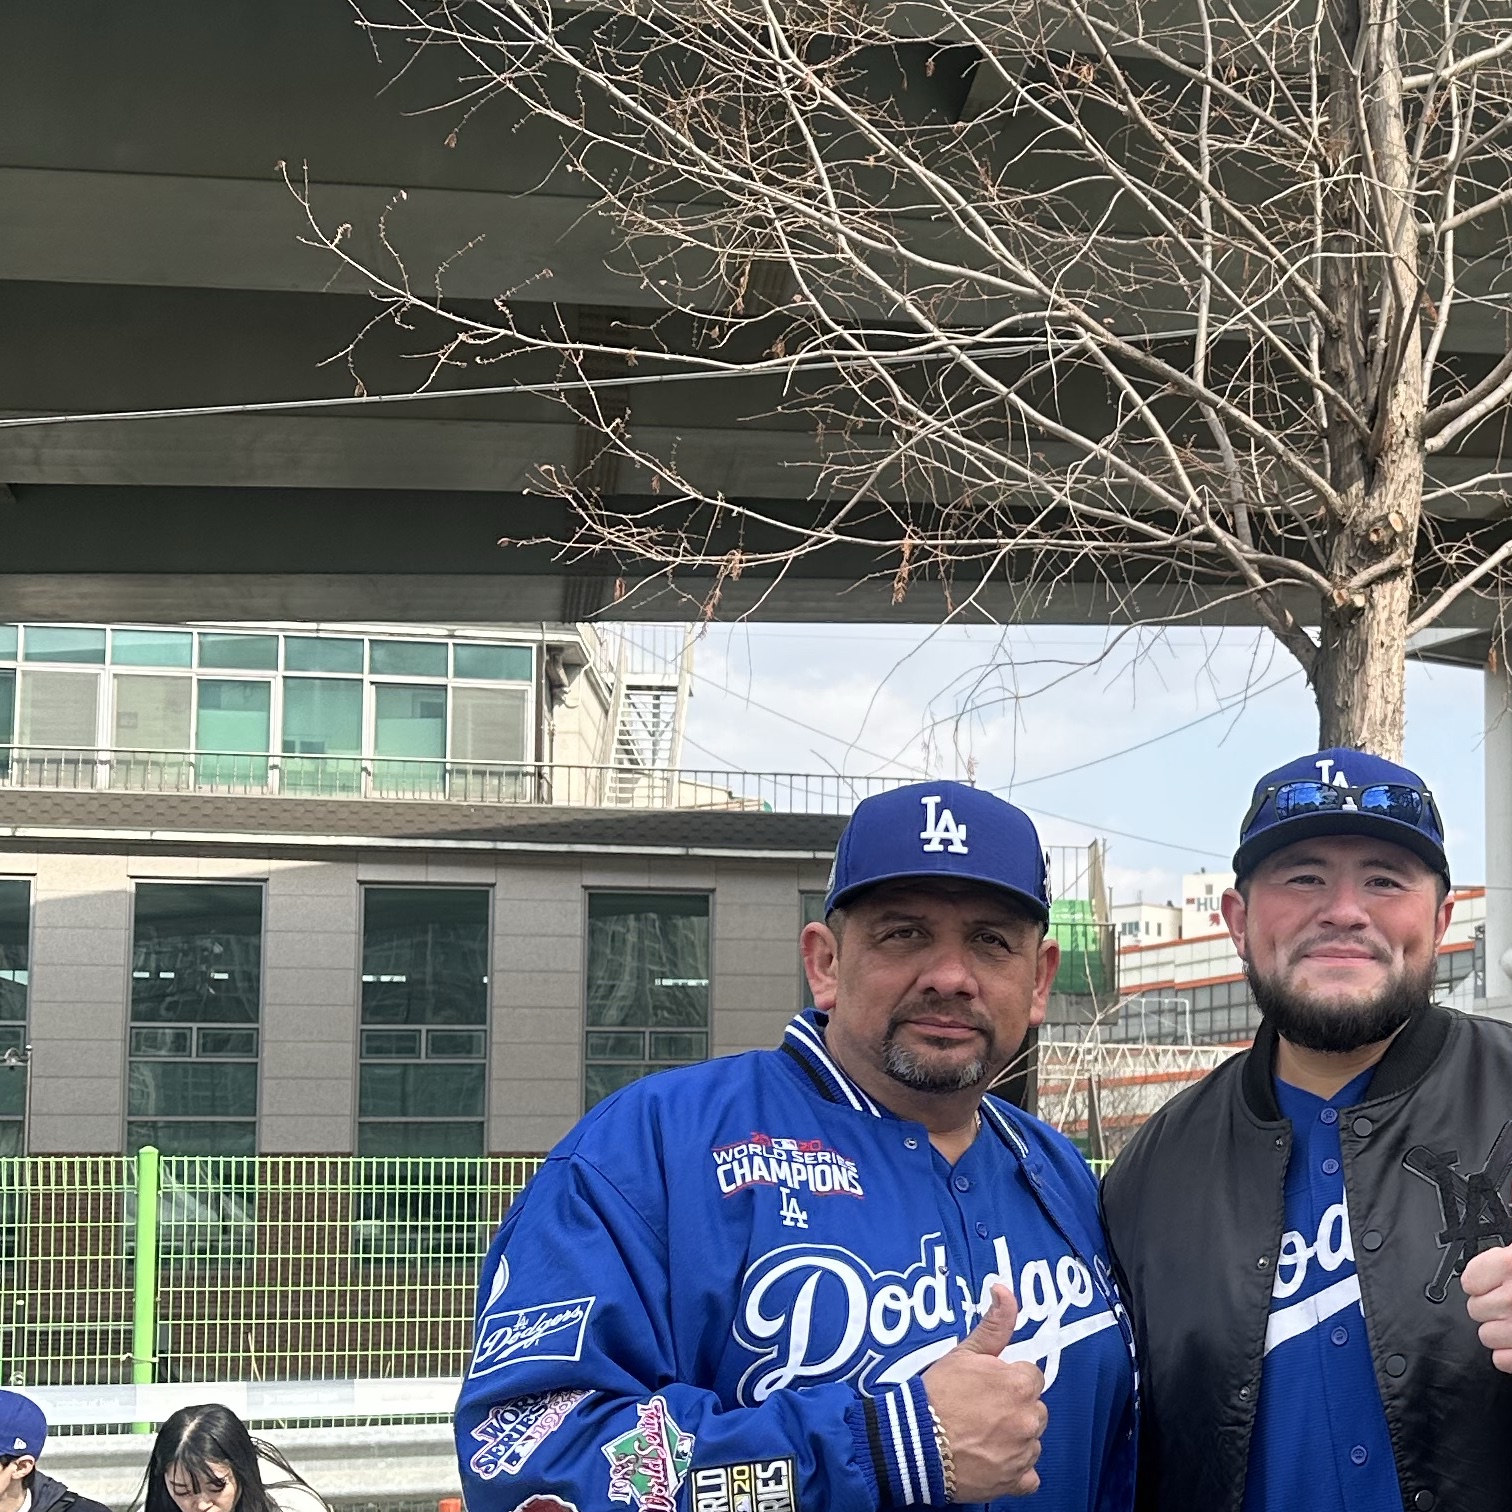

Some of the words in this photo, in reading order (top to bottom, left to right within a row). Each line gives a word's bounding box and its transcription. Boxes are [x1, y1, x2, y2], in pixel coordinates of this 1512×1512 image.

[919, 795, 969, 855] LA
[712, 1143, 787, 1165] WORLD
[792, 1151, 858, 1174] SERIES
[716, 1156, 864, 1196] CHAMPIONS
[779, 1186, 809, 1229] LA
[732, 1465, 752, 1494] 20
